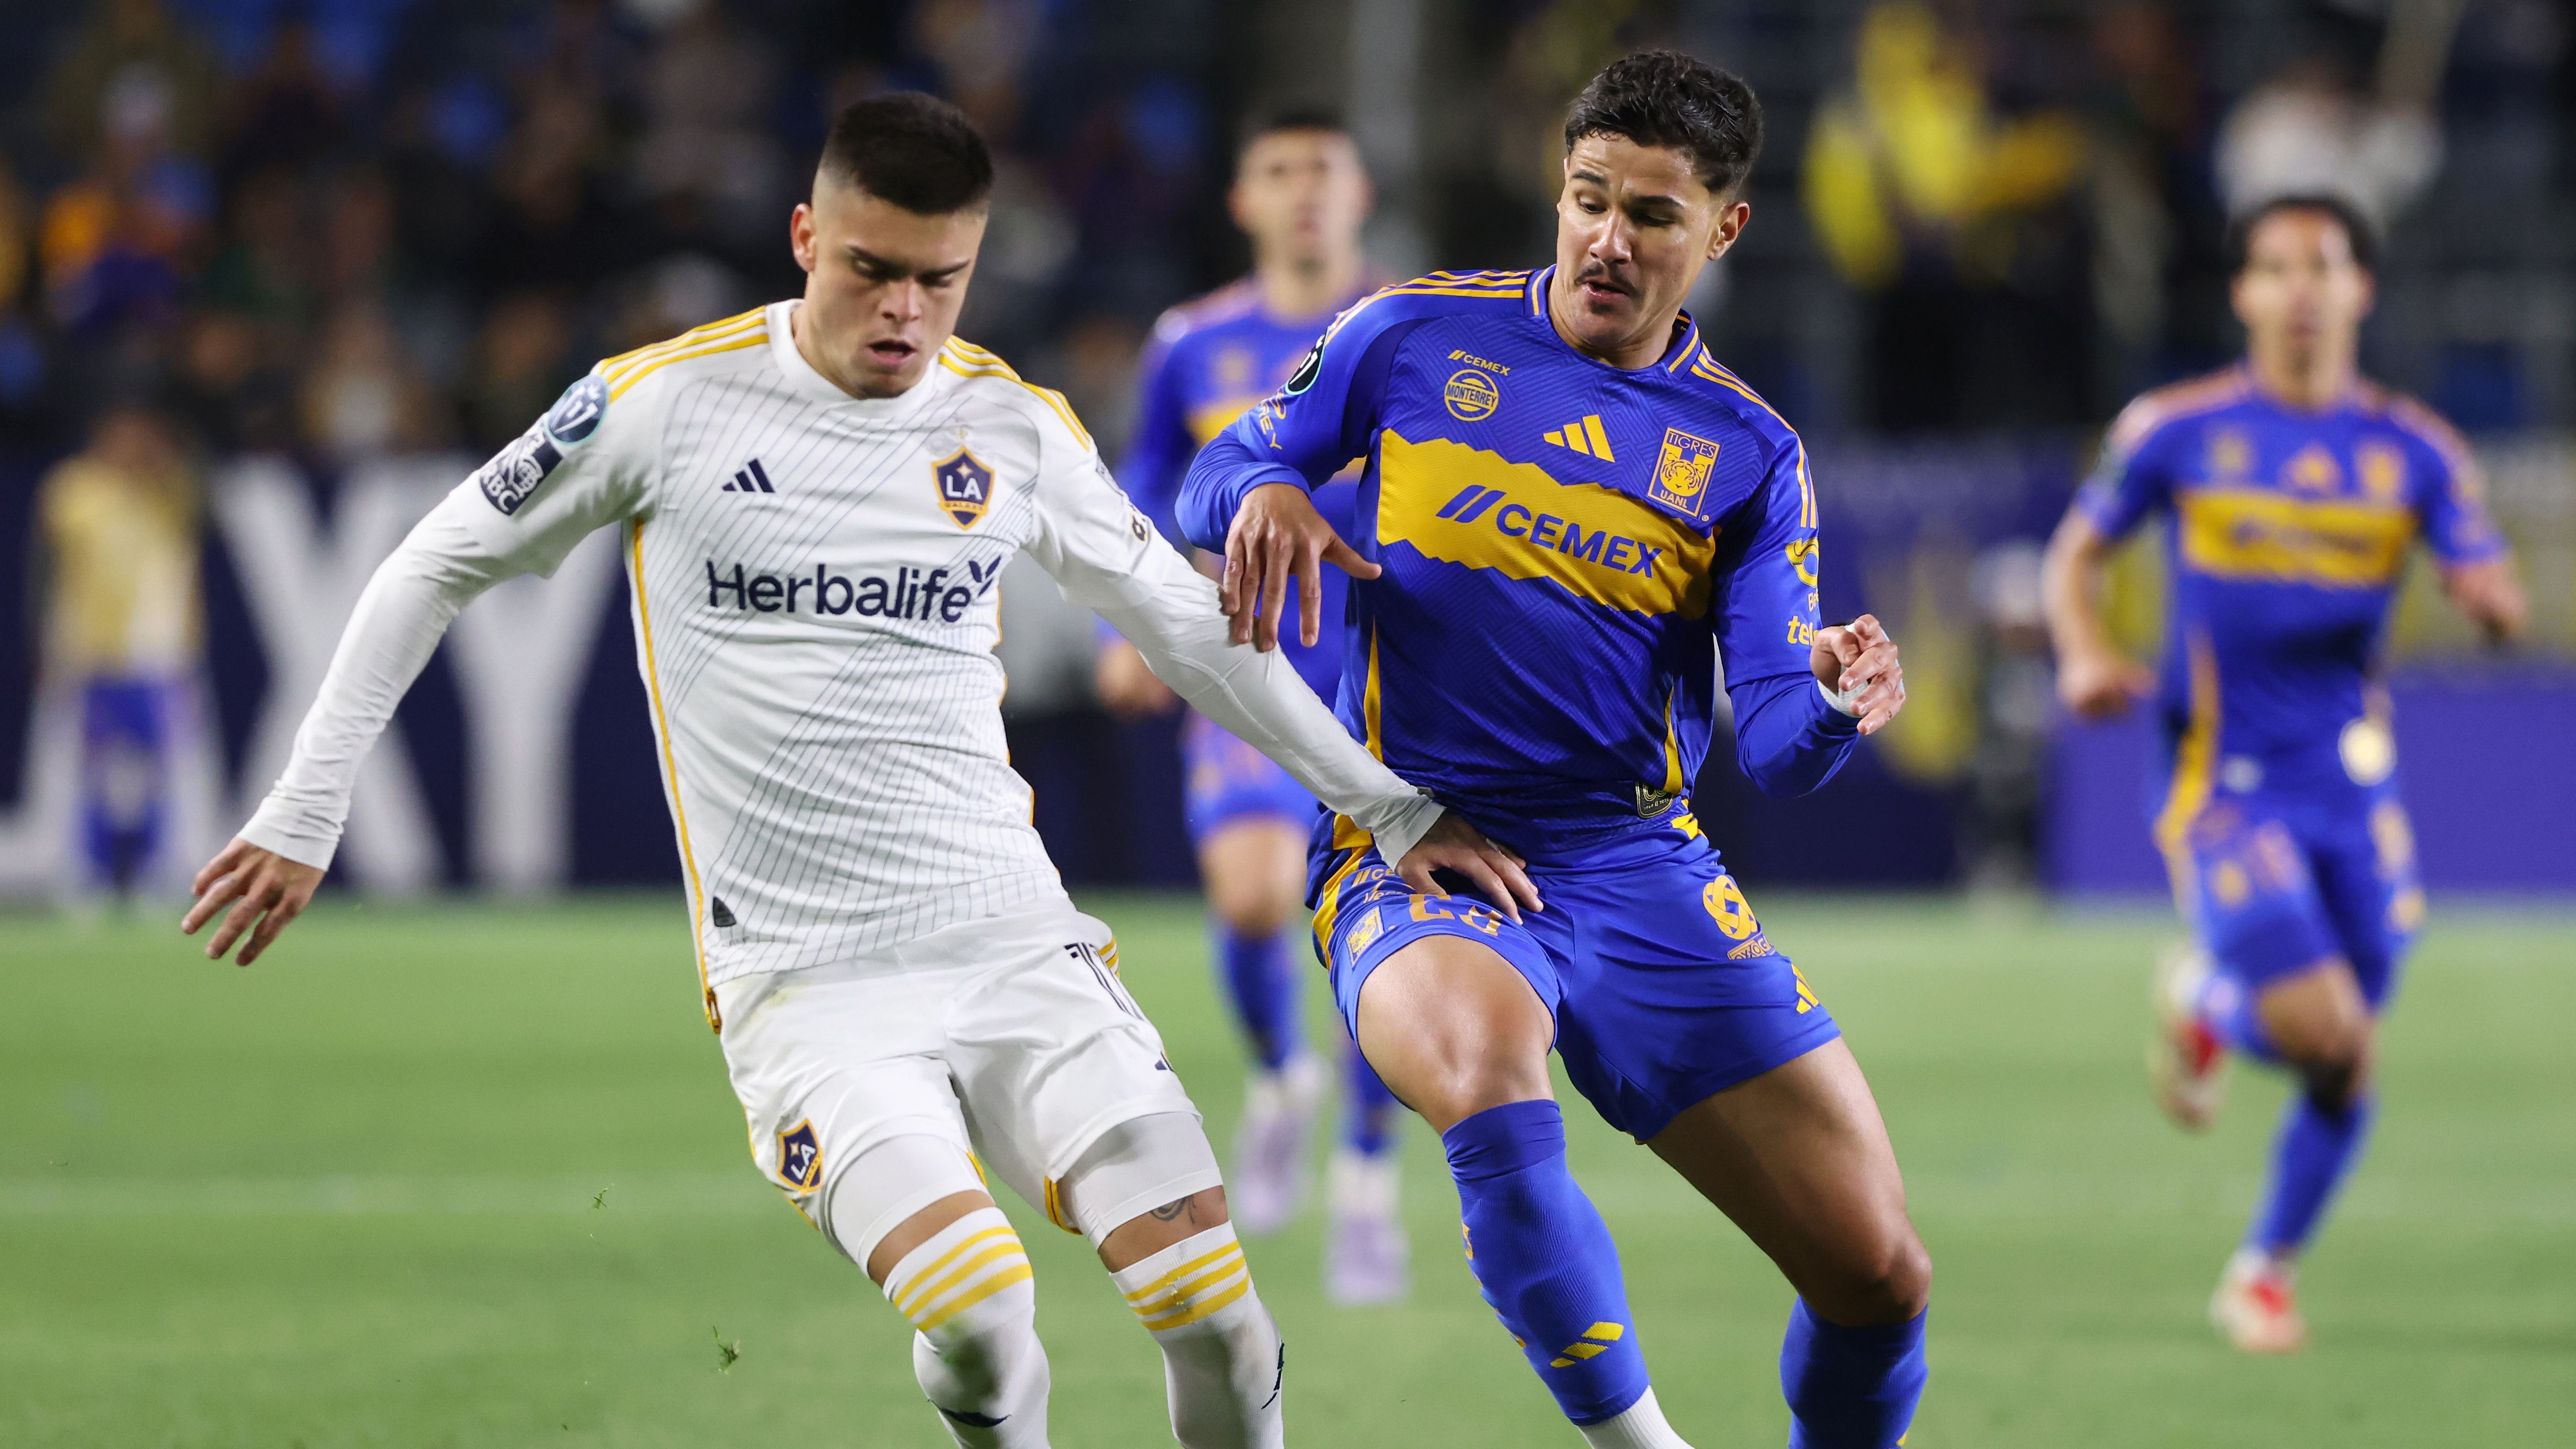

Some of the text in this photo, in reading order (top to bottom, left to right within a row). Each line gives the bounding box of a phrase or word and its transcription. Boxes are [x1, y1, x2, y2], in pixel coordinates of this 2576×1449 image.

[1463, 354, 1511, 376] CEMEX
[1446, 383, 1498, 408] MONTERREY
[1669, 432, 1715, 458] TIGRES
[480, 463, 519, 512] RBC
[946, 474, 983, 500] LA
[1660, 489, 1687, 508] UANL
[1495, 503, 1663, 578] CEMEX
[706, 560, 971, 622] Herbalife
[790, 1143, 817, 1180] LA
